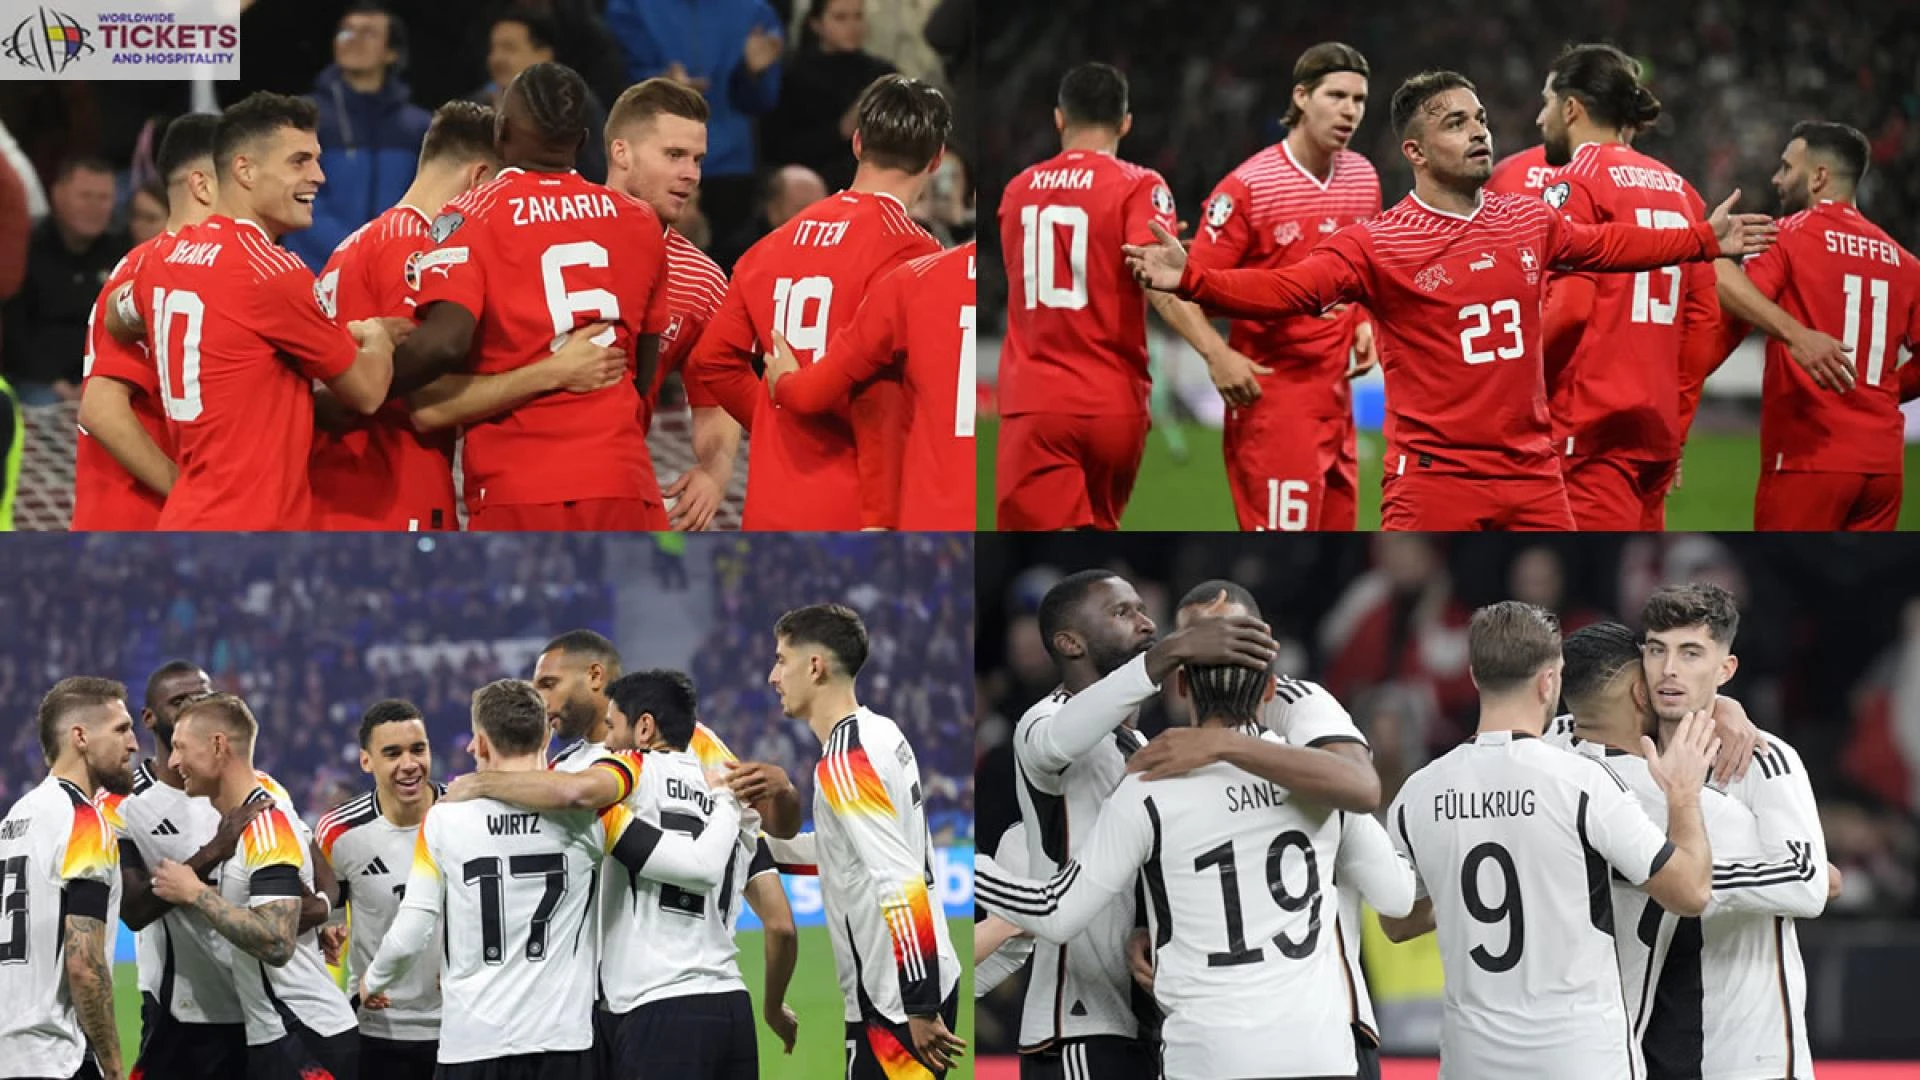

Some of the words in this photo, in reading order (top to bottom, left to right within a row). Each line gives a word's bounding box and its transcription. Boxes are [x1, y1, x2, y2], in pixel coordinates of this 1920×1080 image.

[509, 194, 618, 226] ZAKARIA
[1029, 168, 1094, 190] XHAKA
[1608, 165, 1687, 196] RODRIGUEZ
[793, 219, 850, 247] ITTEN
[1021, 204, 1088, 310] 10
[1824, 230, 1900, 267] STEFFEN
[541, 241, 620, 352] 6
[773, 275, 833, 364] 19
[1842, 273, 1888, 386] 11
[153, 287, 205, 421] 10
[1459, 298, 1525, 365] 23
[1268, 478, 1309, 531] 16
[487, 813, 541, 835] WIRTZ
[1434, 788, 1535, 822] FÜLLKRUG
[463, 853, 569, 966] 17
[1194, 829, 1323, 967] 19
[1461, 841, 1525, 973] 9
